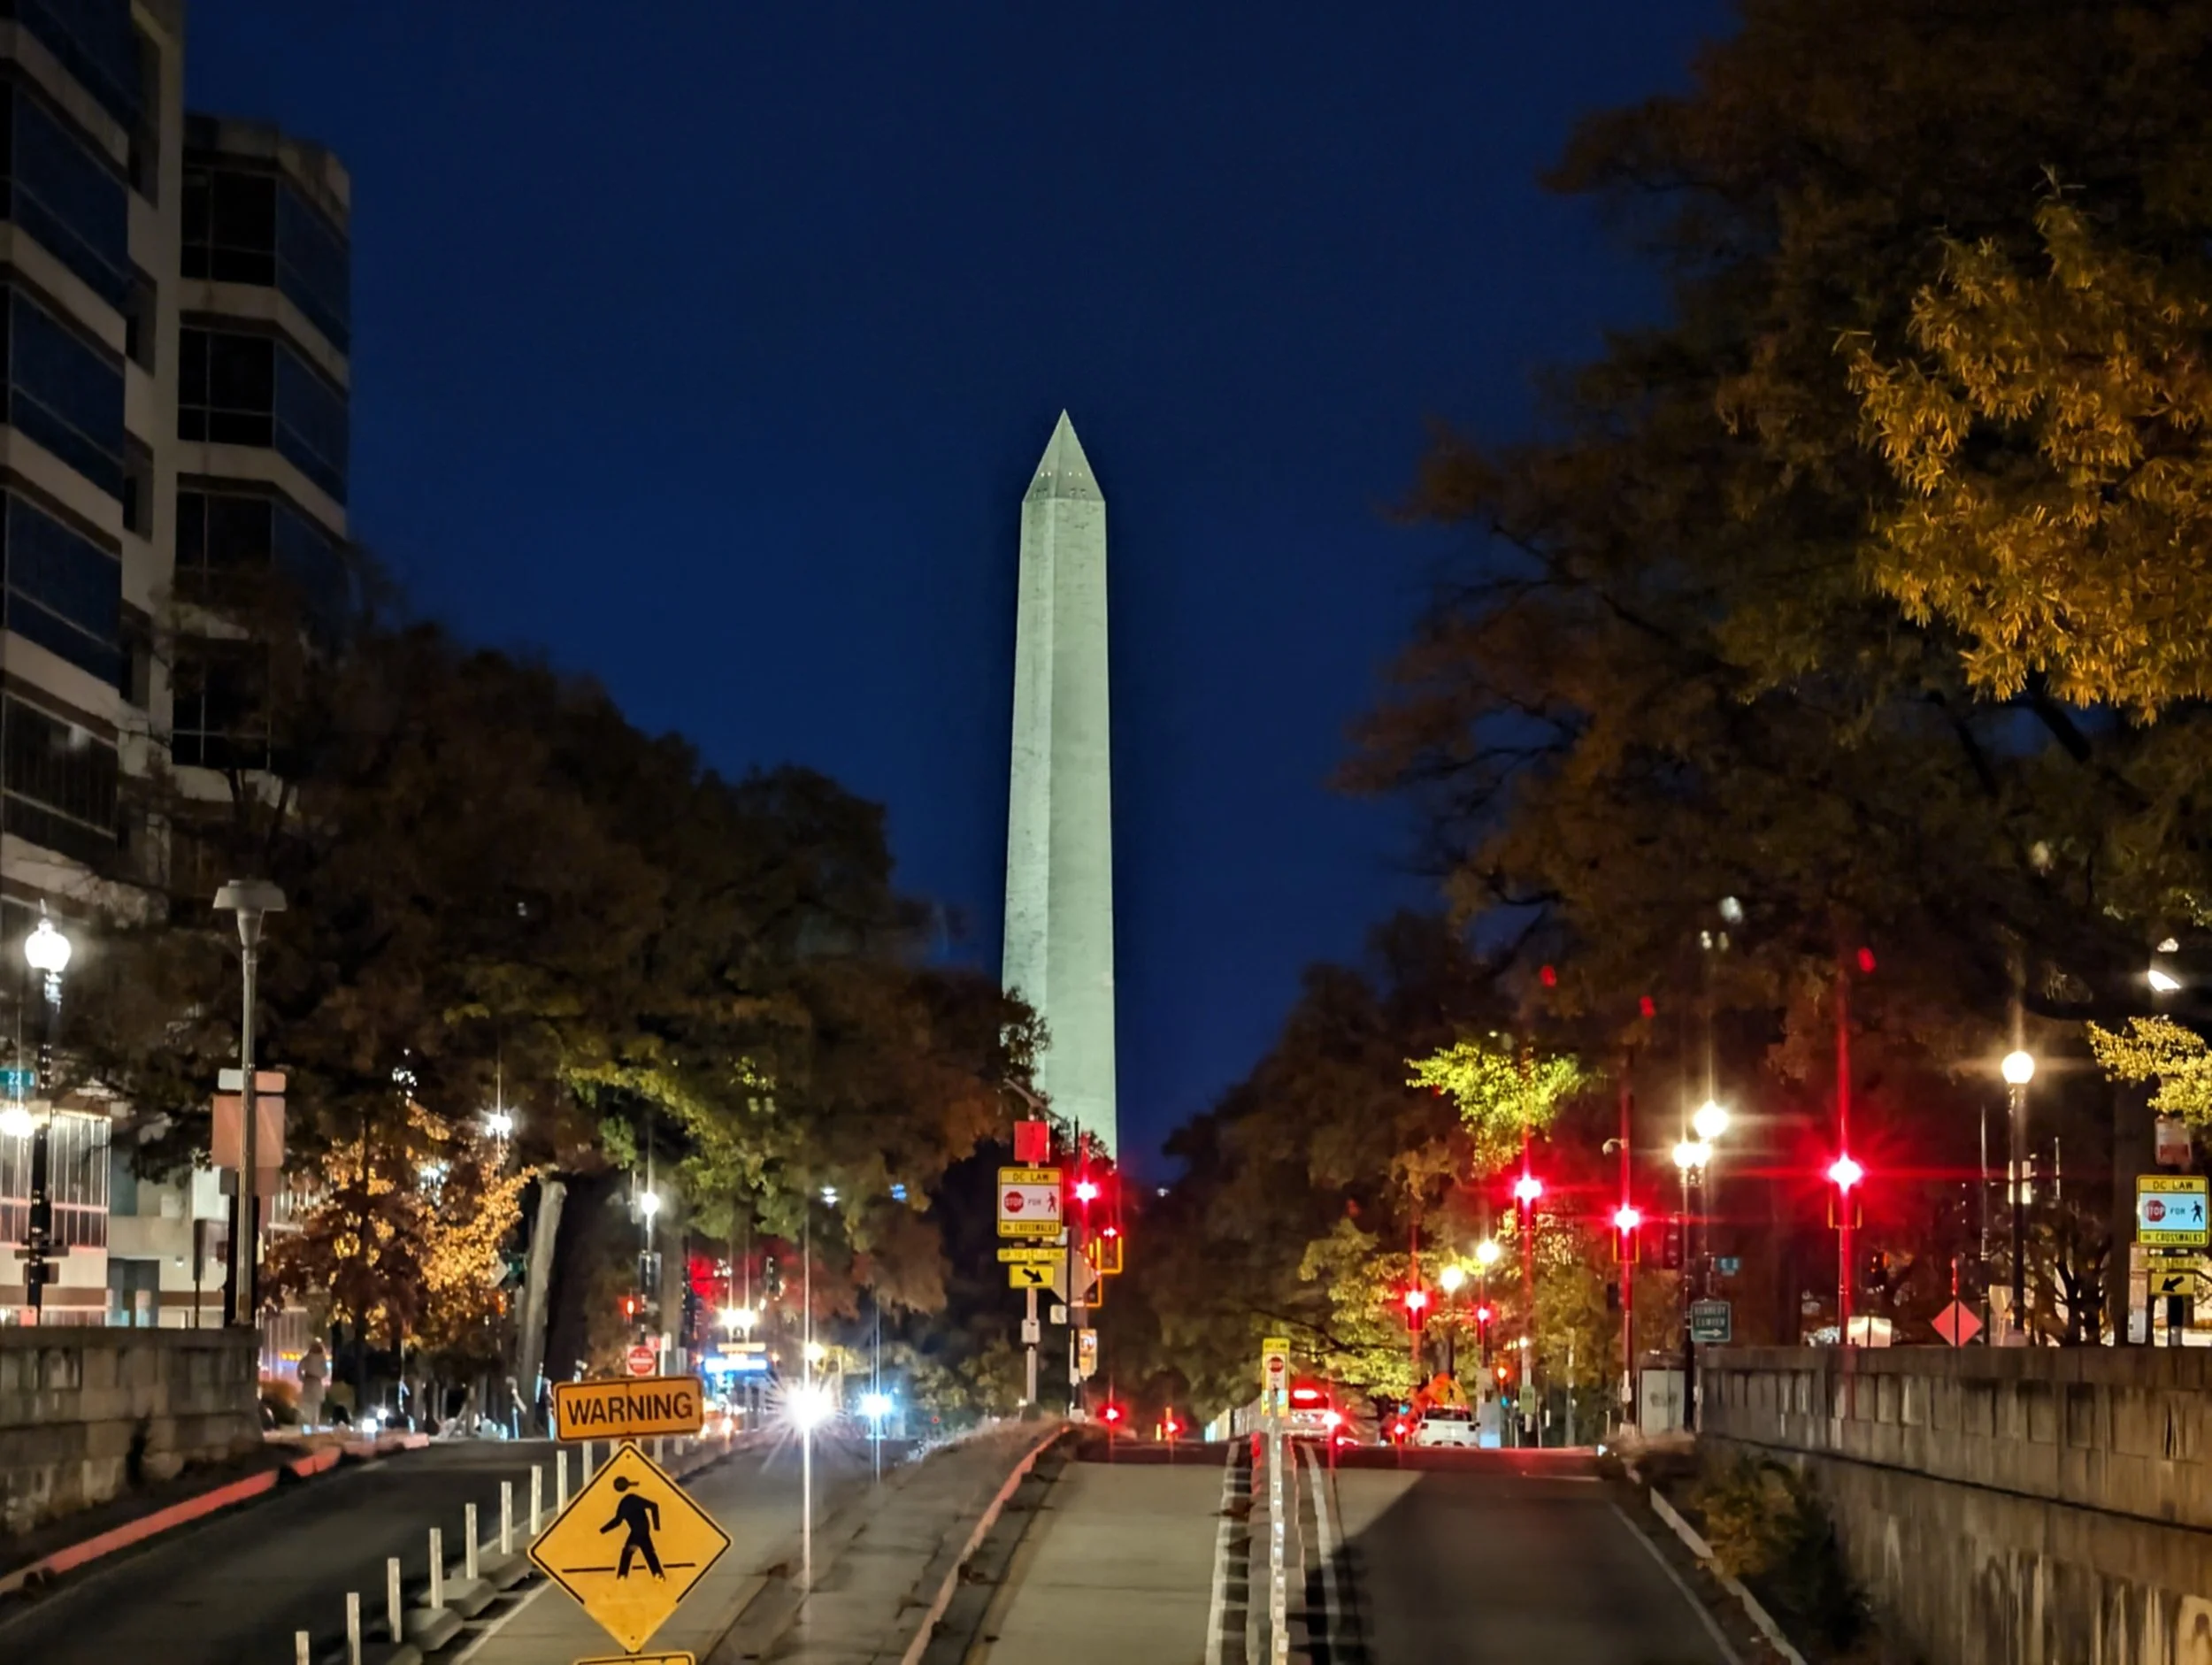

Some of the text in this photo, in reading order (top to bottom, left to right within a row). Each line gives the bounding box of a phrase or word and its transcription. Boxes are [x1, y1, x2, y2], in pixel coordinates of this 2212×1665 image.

[1012, 1172, 1048, 1182] DC LAW
[2153, 1180, 2193, 1190] DC LAW
[2145, 1206, 2185, 1216] STOP FOR
[2155, 1233, 2203, 1242] CROSSWALKS
[566, 1391, 693, 1426] WARNING
